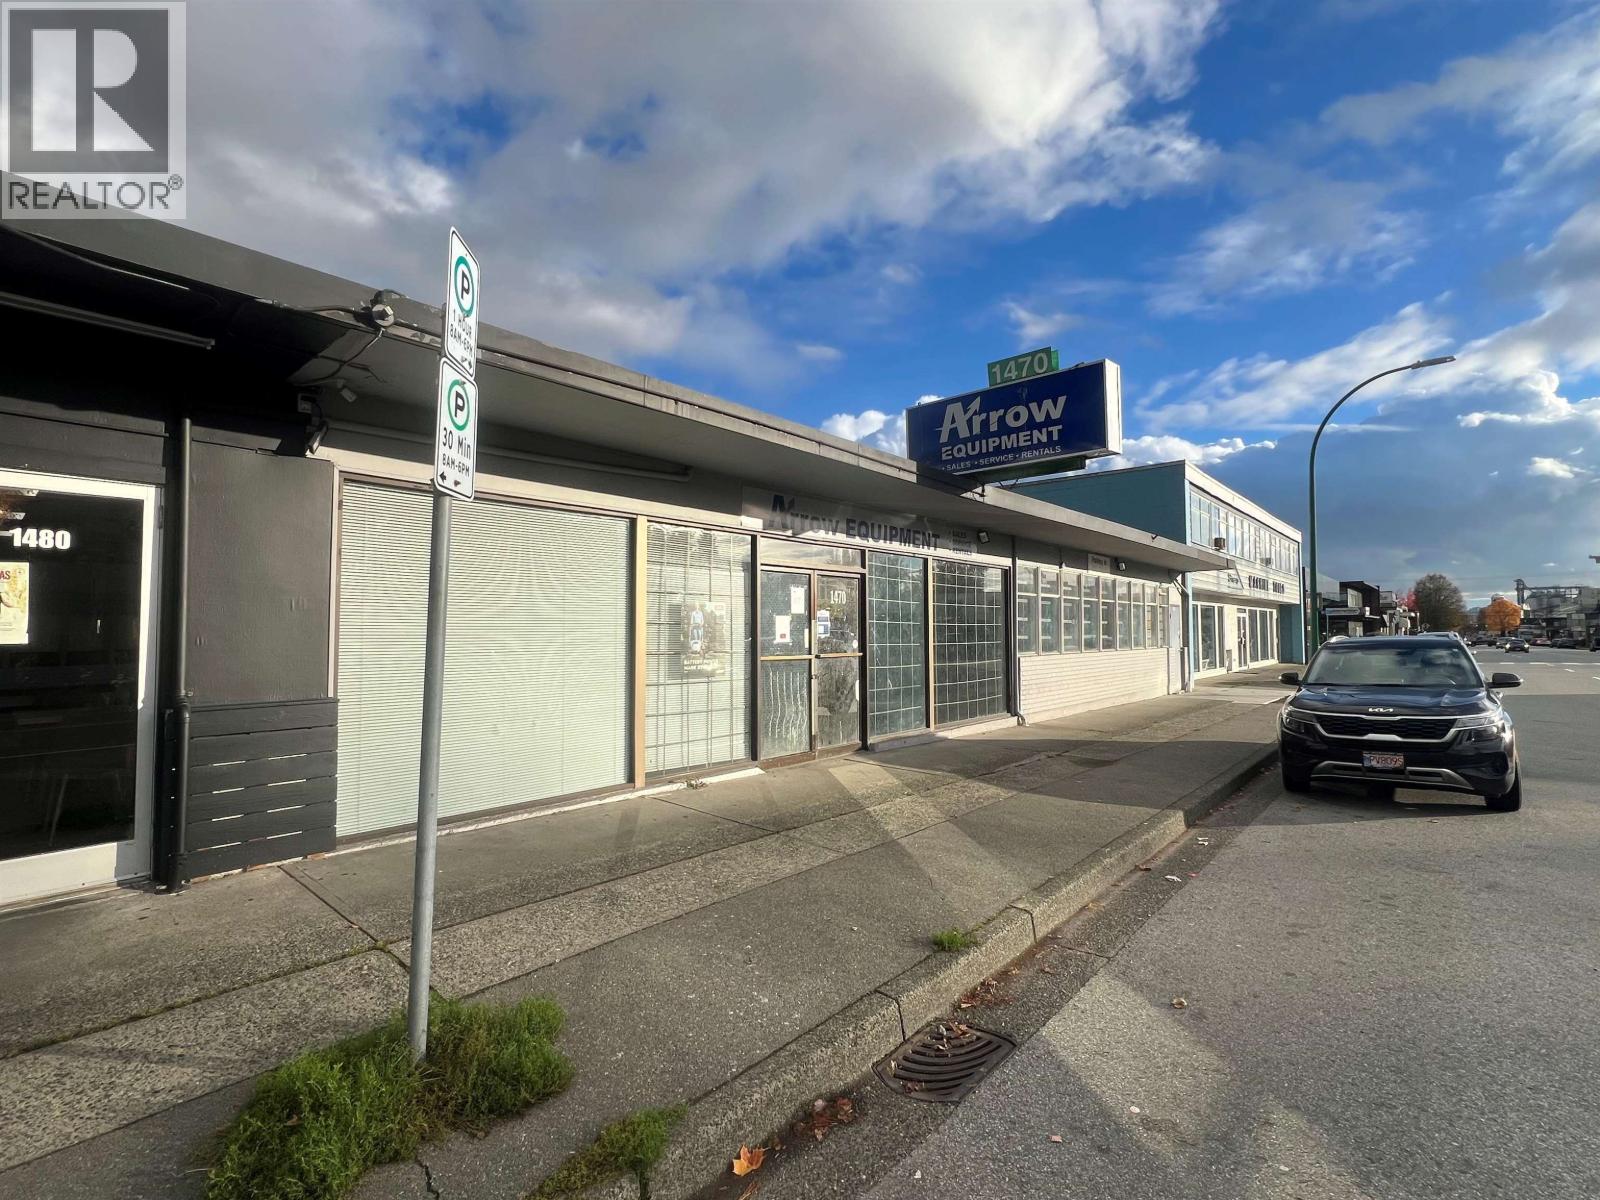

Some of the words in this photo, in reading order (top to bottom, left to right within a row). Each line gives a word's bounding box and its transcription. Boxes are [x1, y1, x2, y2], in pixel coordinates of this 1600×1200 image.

[458, 314, 472, 339] HOUR
[991, 352, 1049, 384] 1470
[936, 395, 1067, 444] Arrow
[442, 426, 454, 451] 30
[457, 435, 472, 461] Min
[941, 425, 1063, 461] EQUIPMENT
[442, 453, 470, 477] 8AM-6PM
[946, 460, 971, 472] SALES
[979, 453, 1014, 466] SERVICE
[1020, 445, 1062, 459] RENTALS
[10, 527, 71, 550] 1480
[845, 518, 941, 552] EQUIPMENT
[830, 590, 847, 605] 1470
